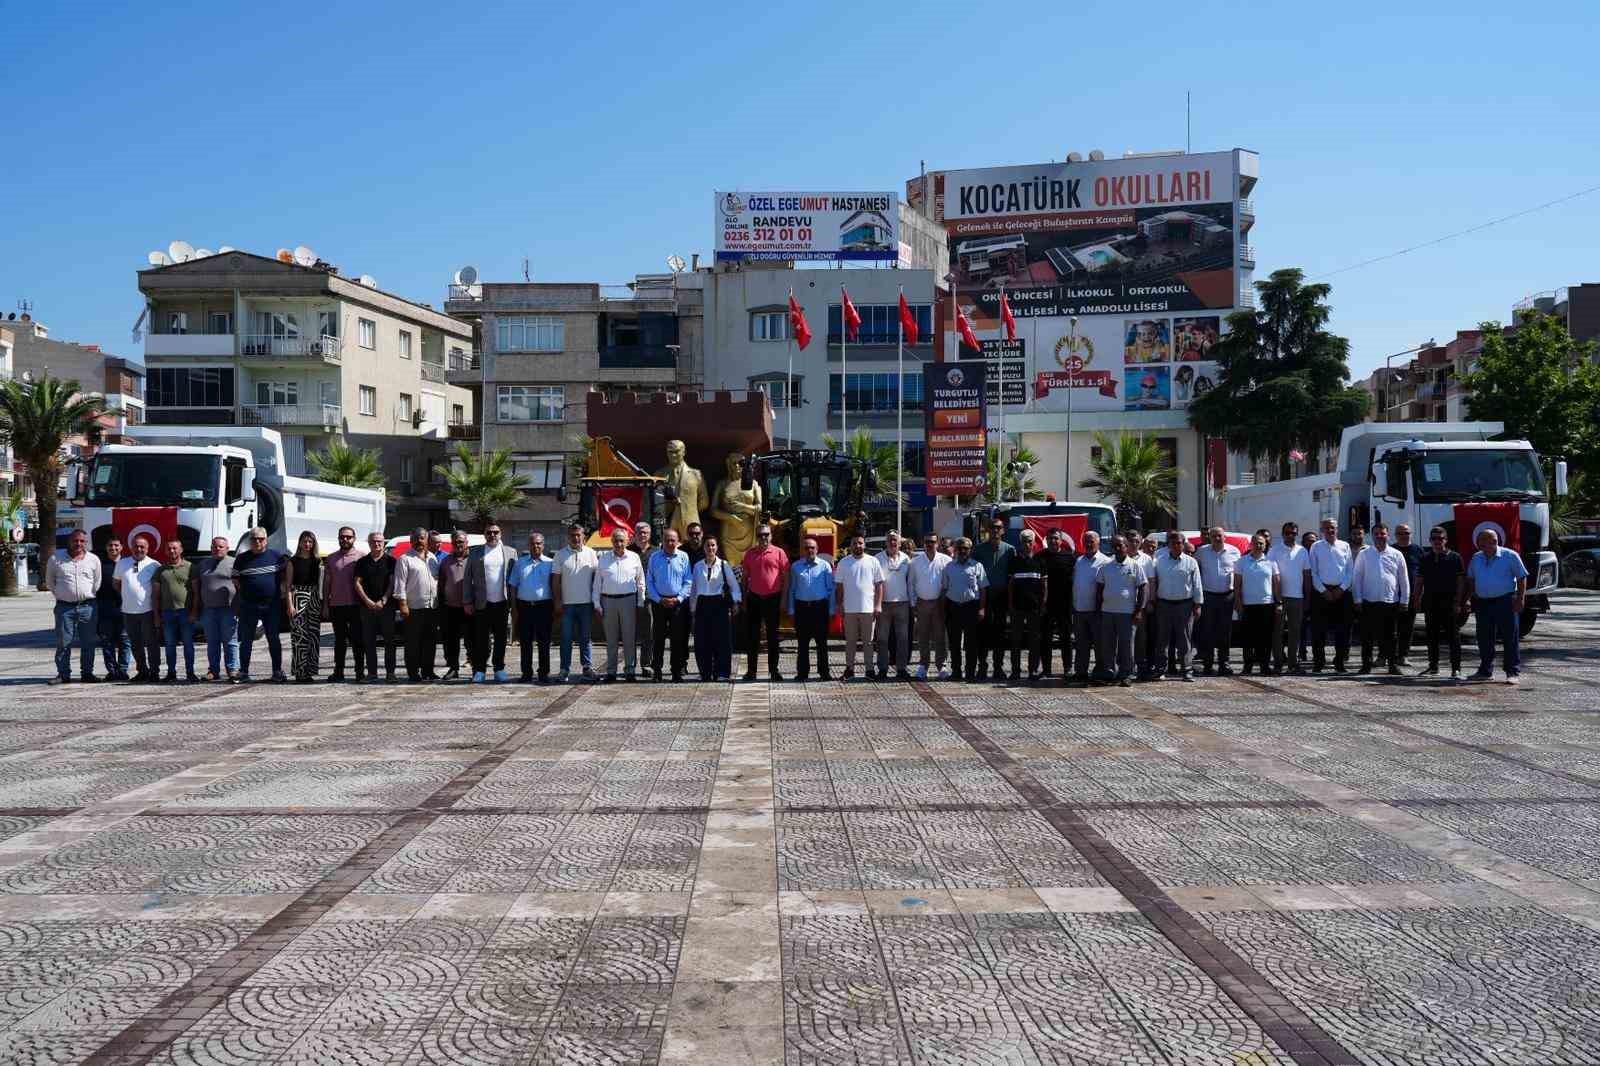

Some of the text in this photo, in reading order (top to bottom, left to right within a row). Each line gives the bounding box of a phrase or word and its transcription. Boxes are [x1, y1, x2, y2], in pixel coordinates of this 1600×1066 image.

[960, 175, 1081, 215] KOCATÜRK
[1094, 170, 1211, 207] OKULLARI
[749, 194, 775, 211] ÖZEL
[778, 196, 829, 211] EGEUMUT
[832, 194, 890, 211] HASTANESİ
[753, 216, 812, 227] RANDEVU
[957, 222, 991, 233] Gelenek
[724, 228, 812, 241] 0236 312 01 01
[725, 243, 811, 251] www.egeumut.com.tr
[1067, 288, 1114, 298] İLKOKUL
[1129, 285, 1189, 295] ORTAOKUL
[982, 290, 1053, 302] OKUL ÖNCESİ
[1024, 305, 1058, 316] LİSESİ
[1062, 307, 1075, 315] ve
[1079, 304, 1131, 314] ANADOLU
[1134, 301, 1168, 312] LİSESİ
[1066, 360, 1082, 369] 25
[934, 389, 978, 398] TURGUTLU
[934, 398, 979, 408] BELEDİYESİ
[946, 413, 968, 424] YENİ
